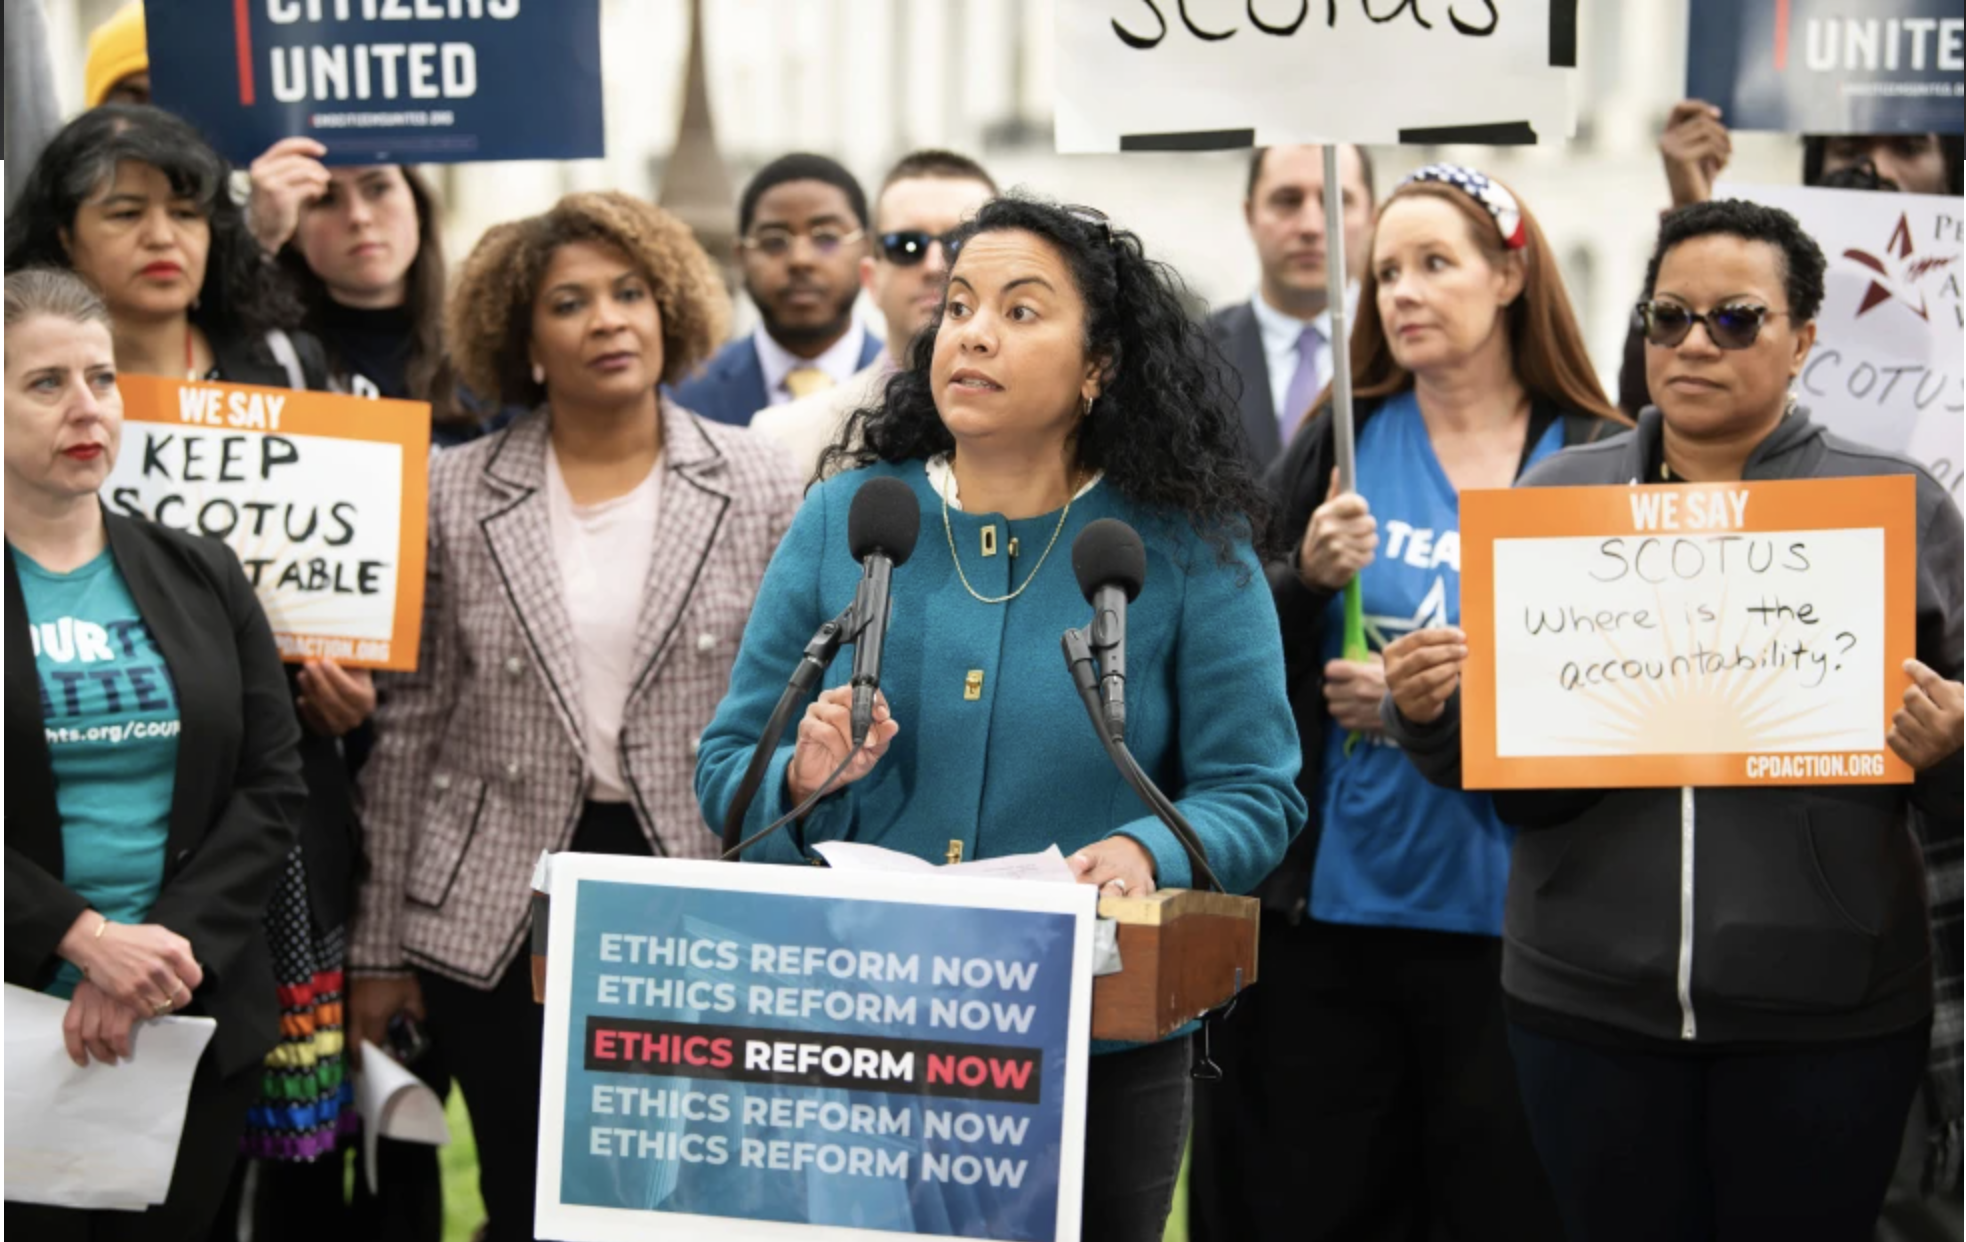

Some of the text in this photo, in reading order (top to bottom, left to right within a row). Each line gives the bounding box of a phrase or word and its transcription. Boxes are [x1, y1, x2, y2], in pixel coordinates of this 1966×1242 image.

[270, 42, 477, 102] UNITED
[178, 387, 285, 430] WE SAY
[142, 433, 299, 482] KEEP
[112, 487, 357, 546] SCOTUS
[1630, 490, 1749, 531] WE SAY
[1588, 536, 1811, 583] SCOTUS
[1685, 600, 1716, 624] is
[1747, 598, 1819, 627] the
[1560, 632, 1857, 690] accountability?
[1747, 754, 1884, 778] CPDACTION.ORG
[600, 934, 1039, 992] ETHICS REFORM NOW
[597, 975, 1036, 1034] ETHICS REFORM NOW
[594, 1029, 1033, 1090] ETHICS REFORM NOW
[591, 1085, 1030, 1146] ETHICS REFORM NOW
[589, 1127, 1028, 1189] ETHICS REFORM NOW
